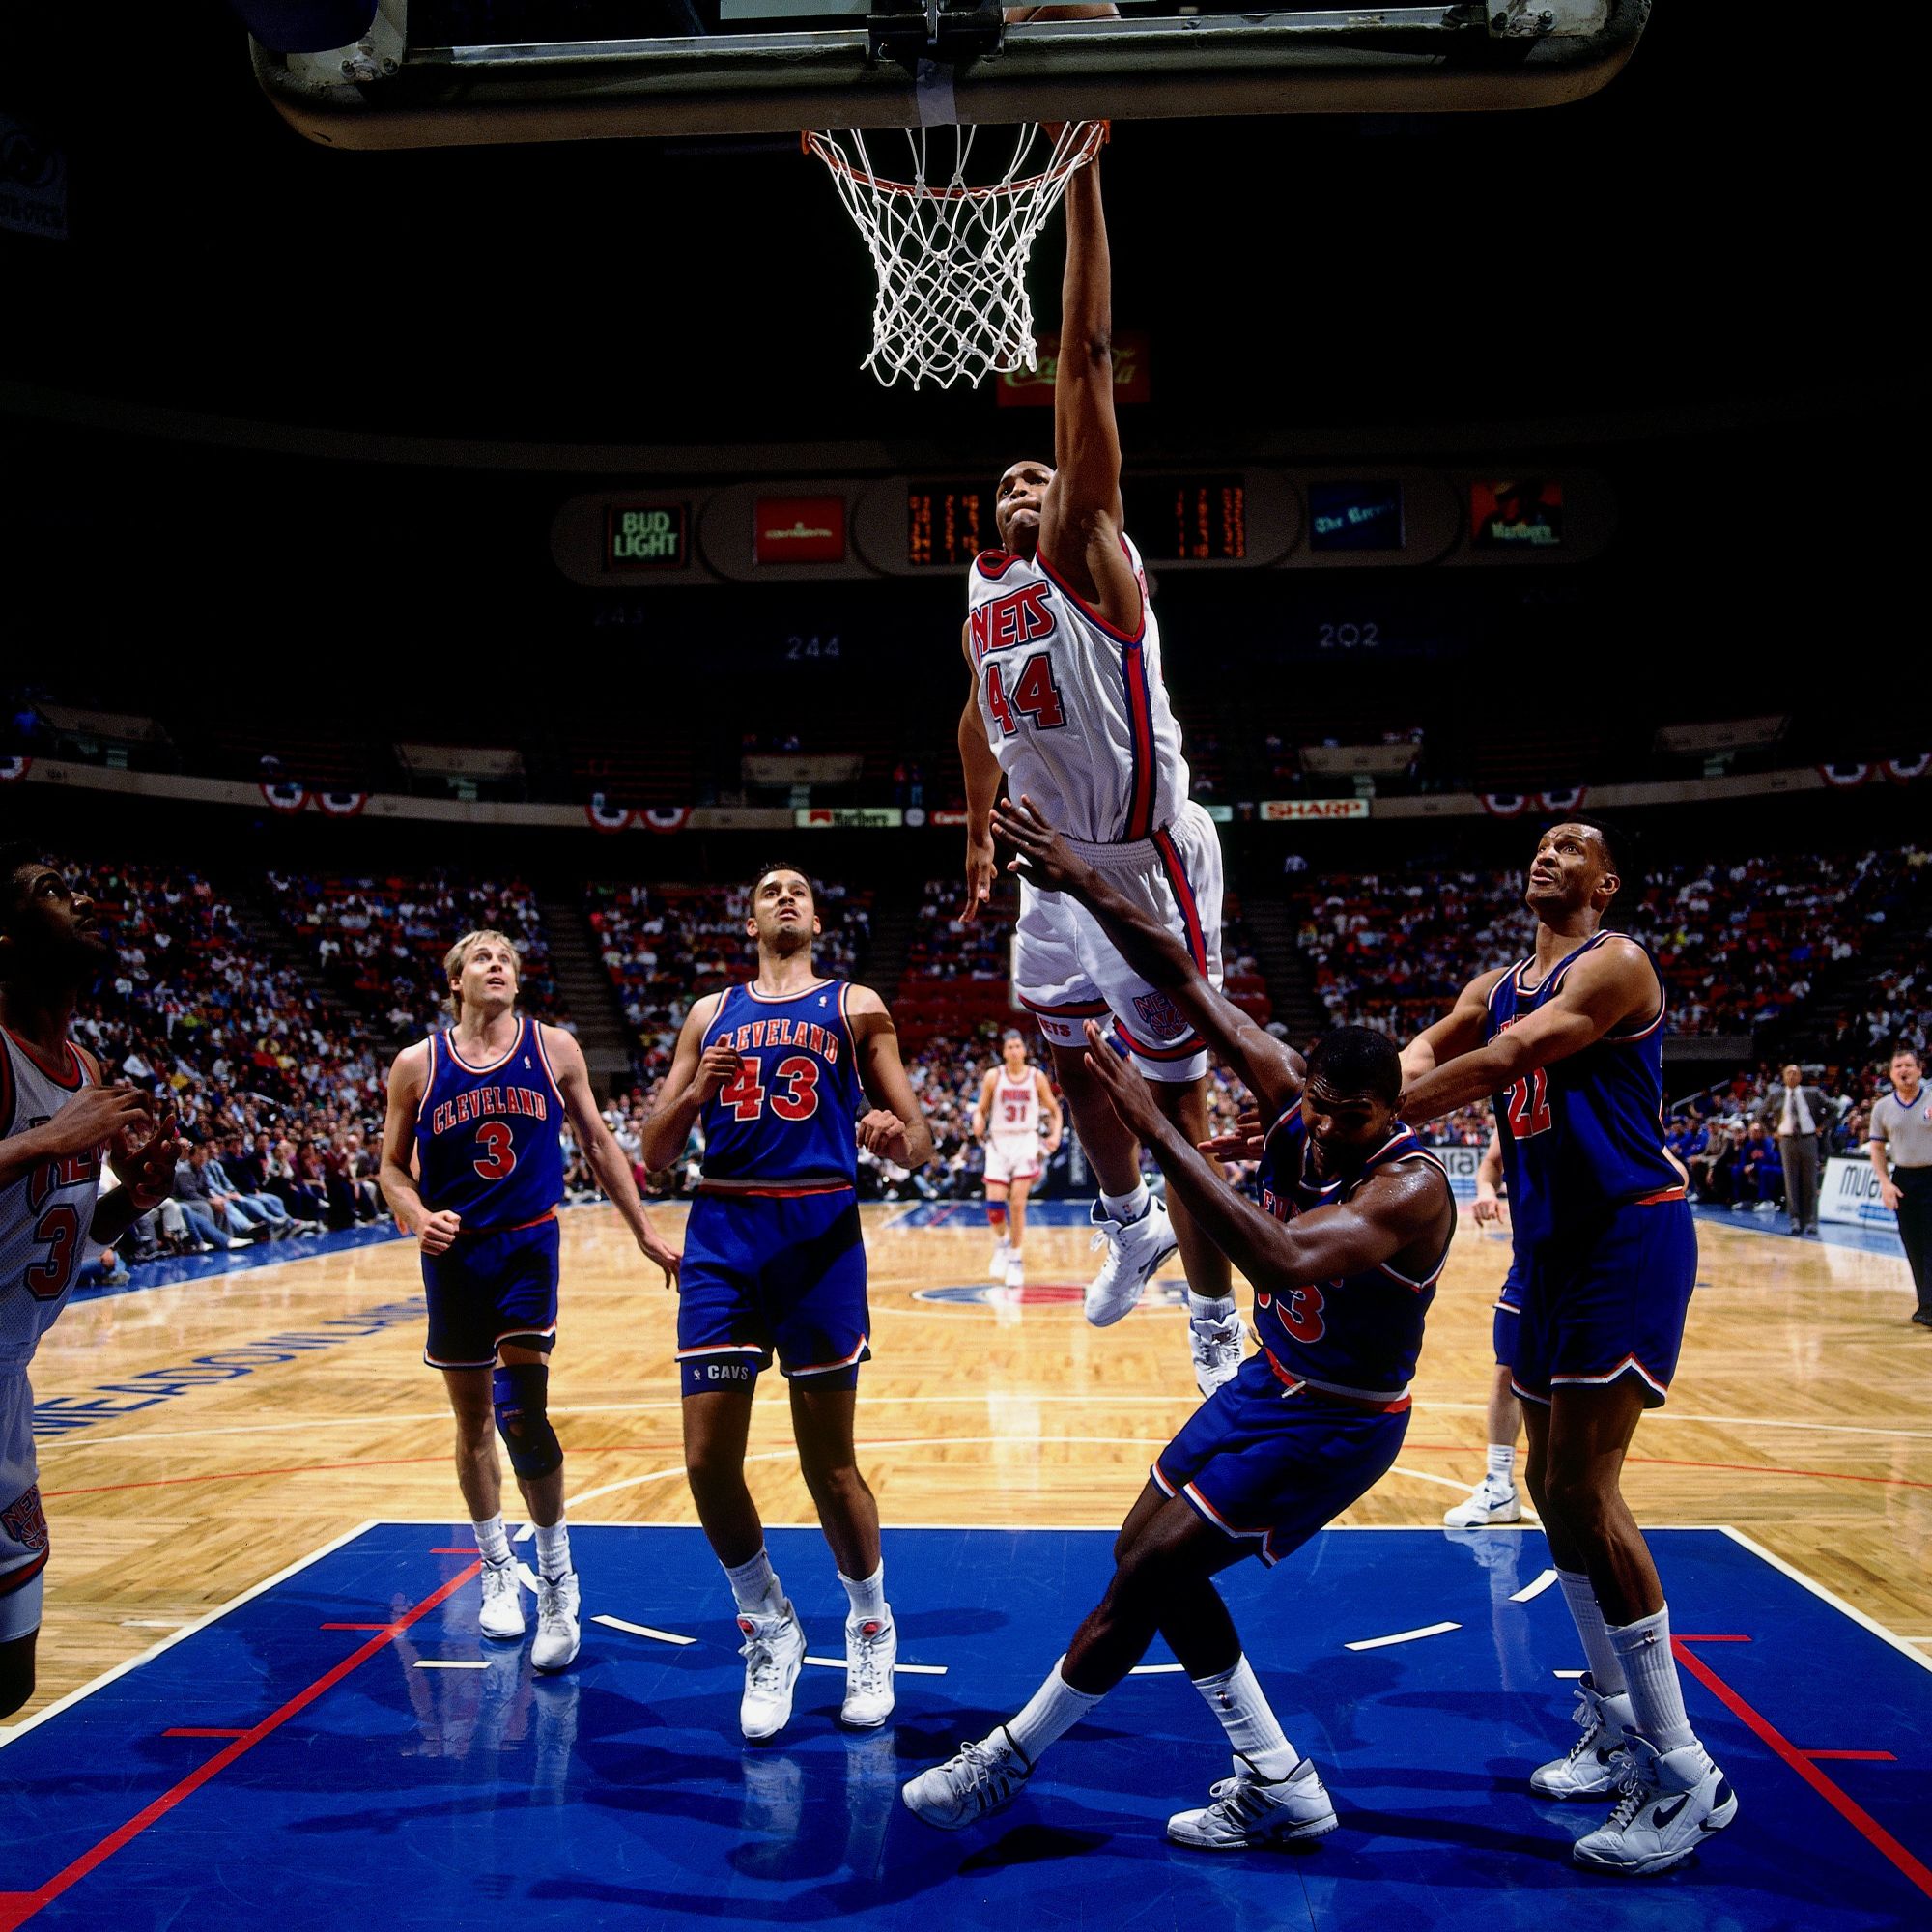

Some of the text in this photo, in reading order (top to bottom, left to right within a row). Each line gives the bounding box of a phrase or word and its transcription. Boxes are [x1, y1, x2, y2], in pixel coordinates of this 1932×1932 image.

[614, 532, 678, 557] LIGHT
[622, 511, 670, 533] BUD
[970, 580, 1056, 666] NETS
[1318, 621, 1380, 648] 202
[785, 634, 840, 661] 244
[986, 652, 1067, 738] 44
[1266, 800, 1362, 818] SHARP
[719, 1018, 839, 1065] LEVELAND
[433, 1086, 547, 1135] CLEVELAND
[720, 1055, 820, 1122] 43
[1503, 1066, 1552, 1140] 22
[1005, 1104, 1027, 1123] 31
[473, 1121, 517, 1180] 3
[23, 1203, 79, 1301] 3
[1257, 1283, 1326, 1344] 3
[707, 1364, 749, 1380] CAVS
